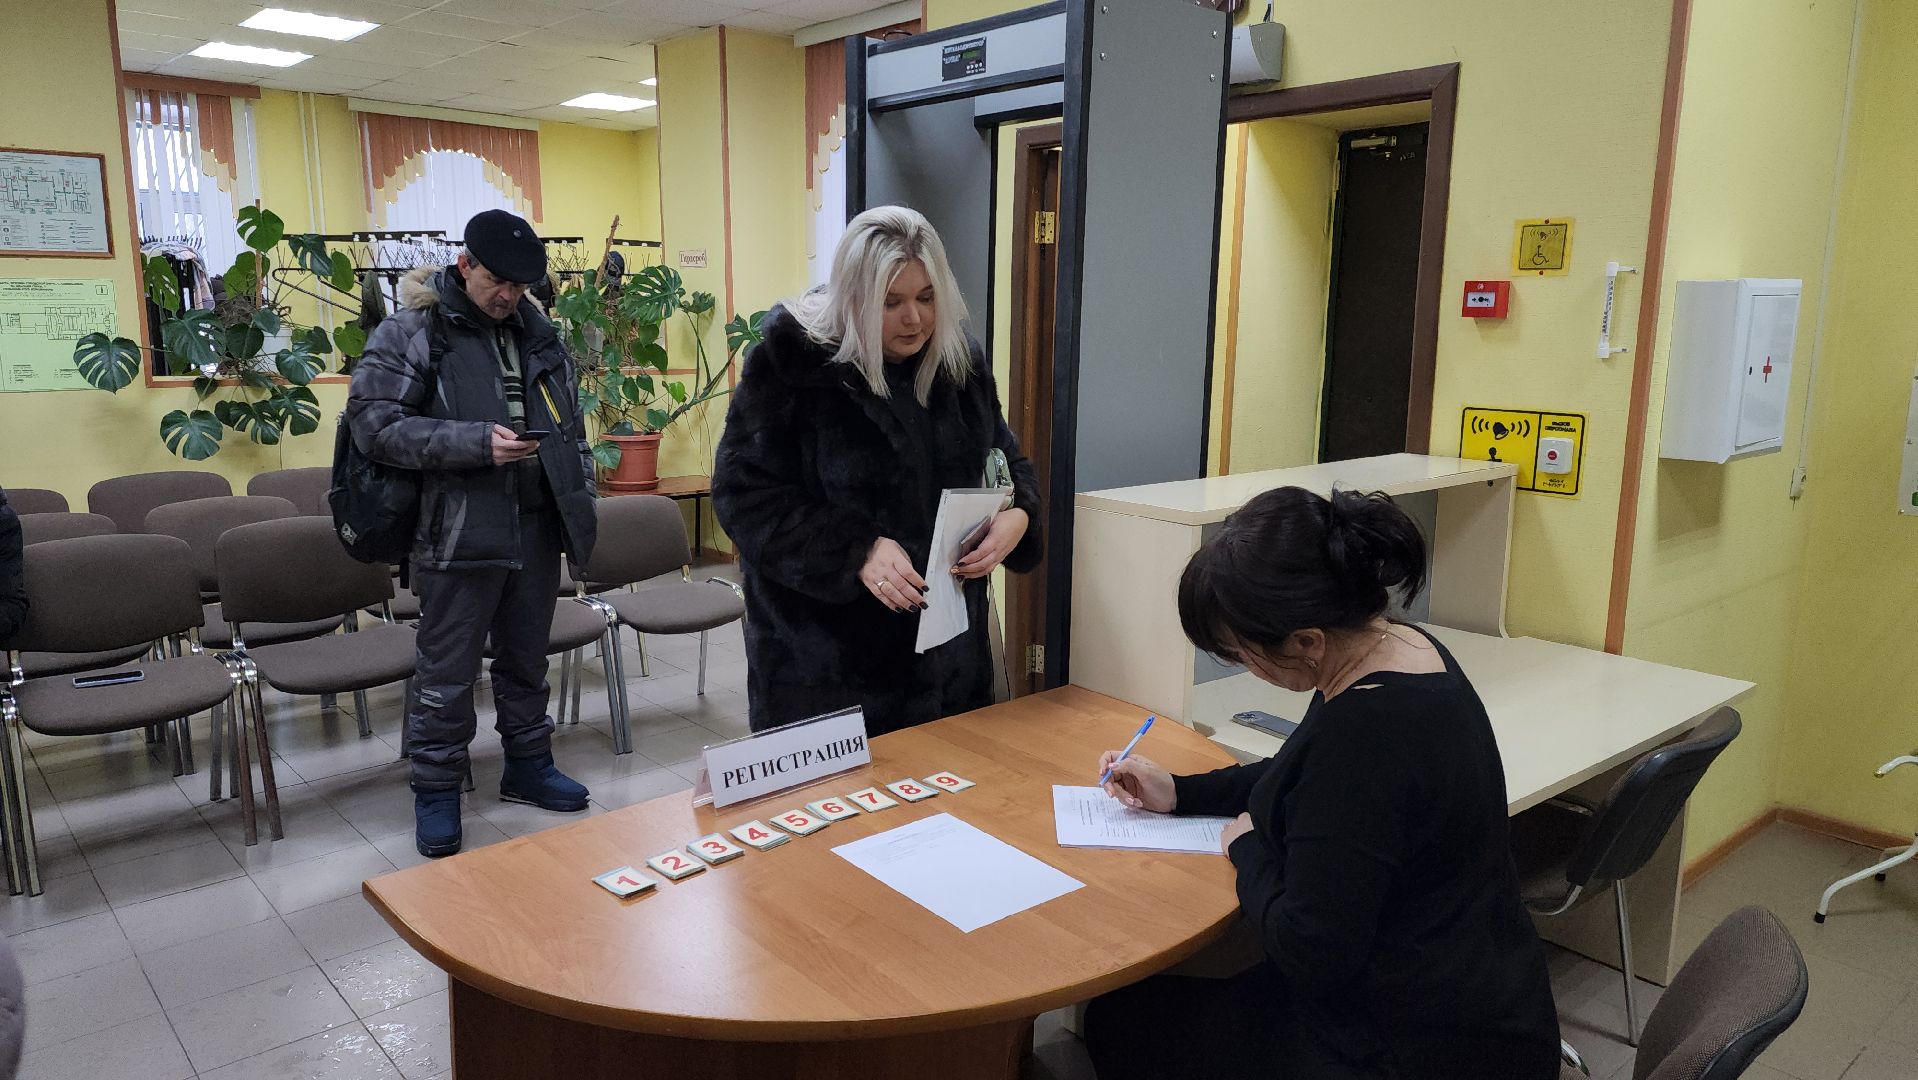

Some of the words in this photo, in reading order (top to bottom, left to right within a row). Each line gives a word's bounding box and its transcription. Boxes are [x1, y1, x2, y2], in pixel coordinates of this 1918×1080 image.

[723, 735, 865, 789] РЕГИСТРАЦИЯ
[936, 775, 959, 787] 9
[898, 784, 922, 795] 8
[858, 791, 878, 805] 7
[821, 802, 844, 814] 6
[784, 814, 809, 827] 5
[748, 827, 769, 841] 4
[702, 841, 728, 854] 3
[661, 856, 690, 871] 2
[616, 875, 640, 887] 1
